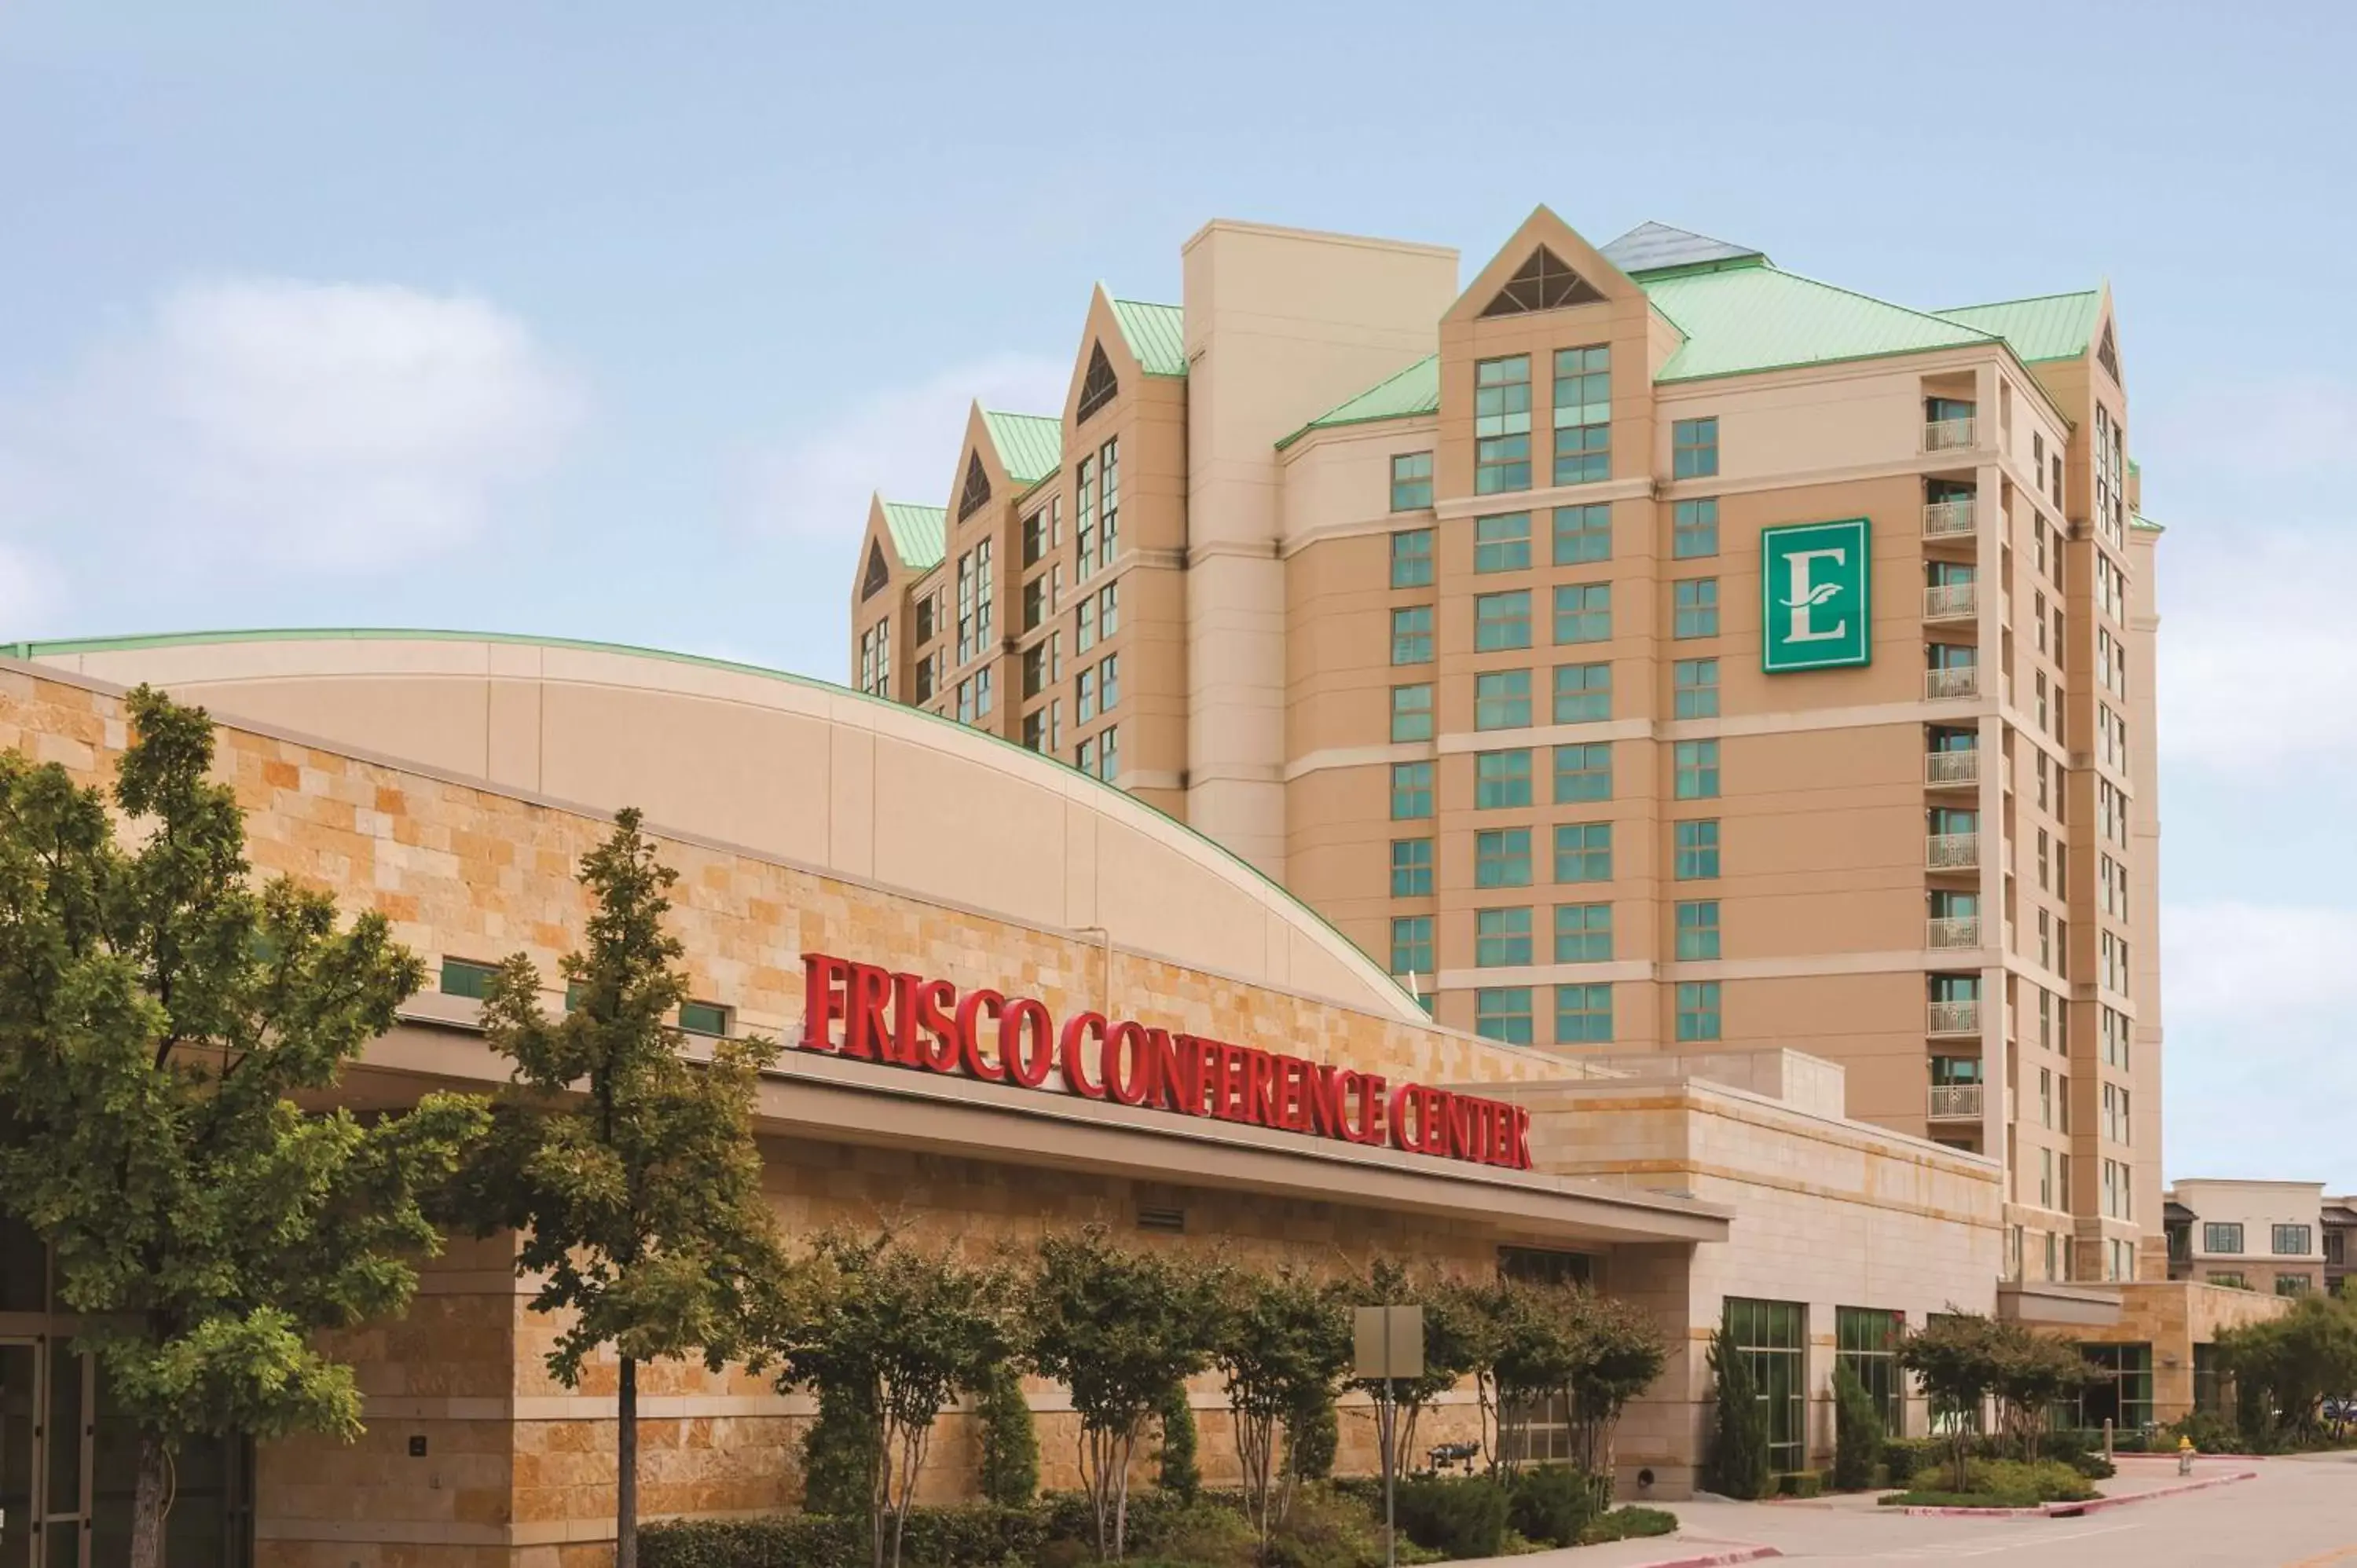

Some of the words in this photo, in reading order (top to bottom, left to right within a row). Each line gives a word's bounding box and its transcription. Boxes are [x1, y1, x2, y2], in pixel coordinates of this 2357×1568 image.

[1780, 548, 1846, 643] E
[799, 953, 1054, 1088] FRISCO
[1061, 1011, 1386, 1146] CONFERENCE
[1389, 1083, 1532, 1170] CENTER
